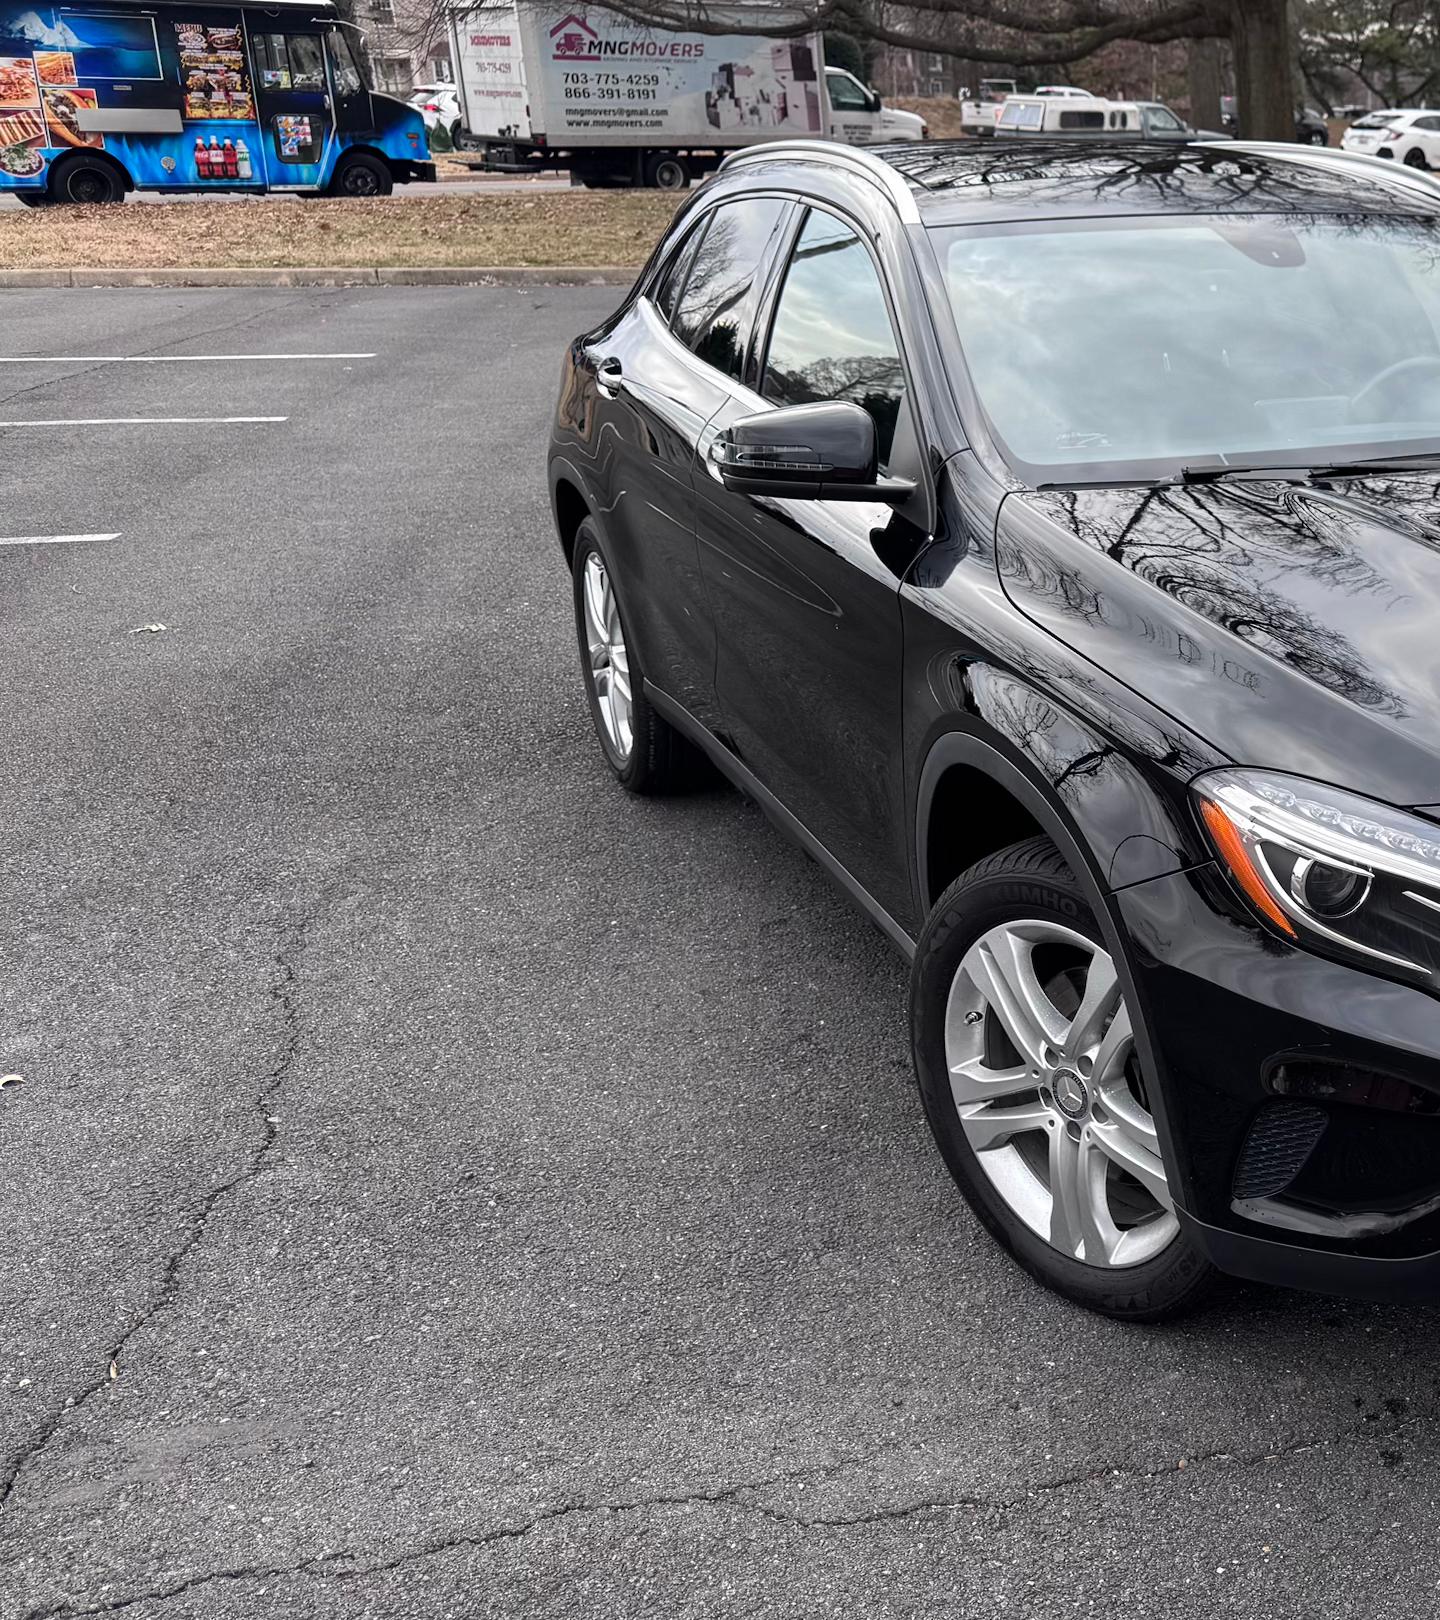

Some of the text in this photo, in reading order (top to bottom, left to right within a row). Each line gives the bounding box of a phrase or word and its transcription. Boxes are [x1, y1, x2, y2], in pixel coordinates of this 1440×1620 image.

[588, 40, 704, 57] MNGMOVERS
[563, 72, 659, 85] 703-775-4259
[565, 87, 656, 99] 866-391-8191
[566, 108, 668, 117] mngmovers@gmail.com
[566, 119, 662, 128] www.mngmovers.com
